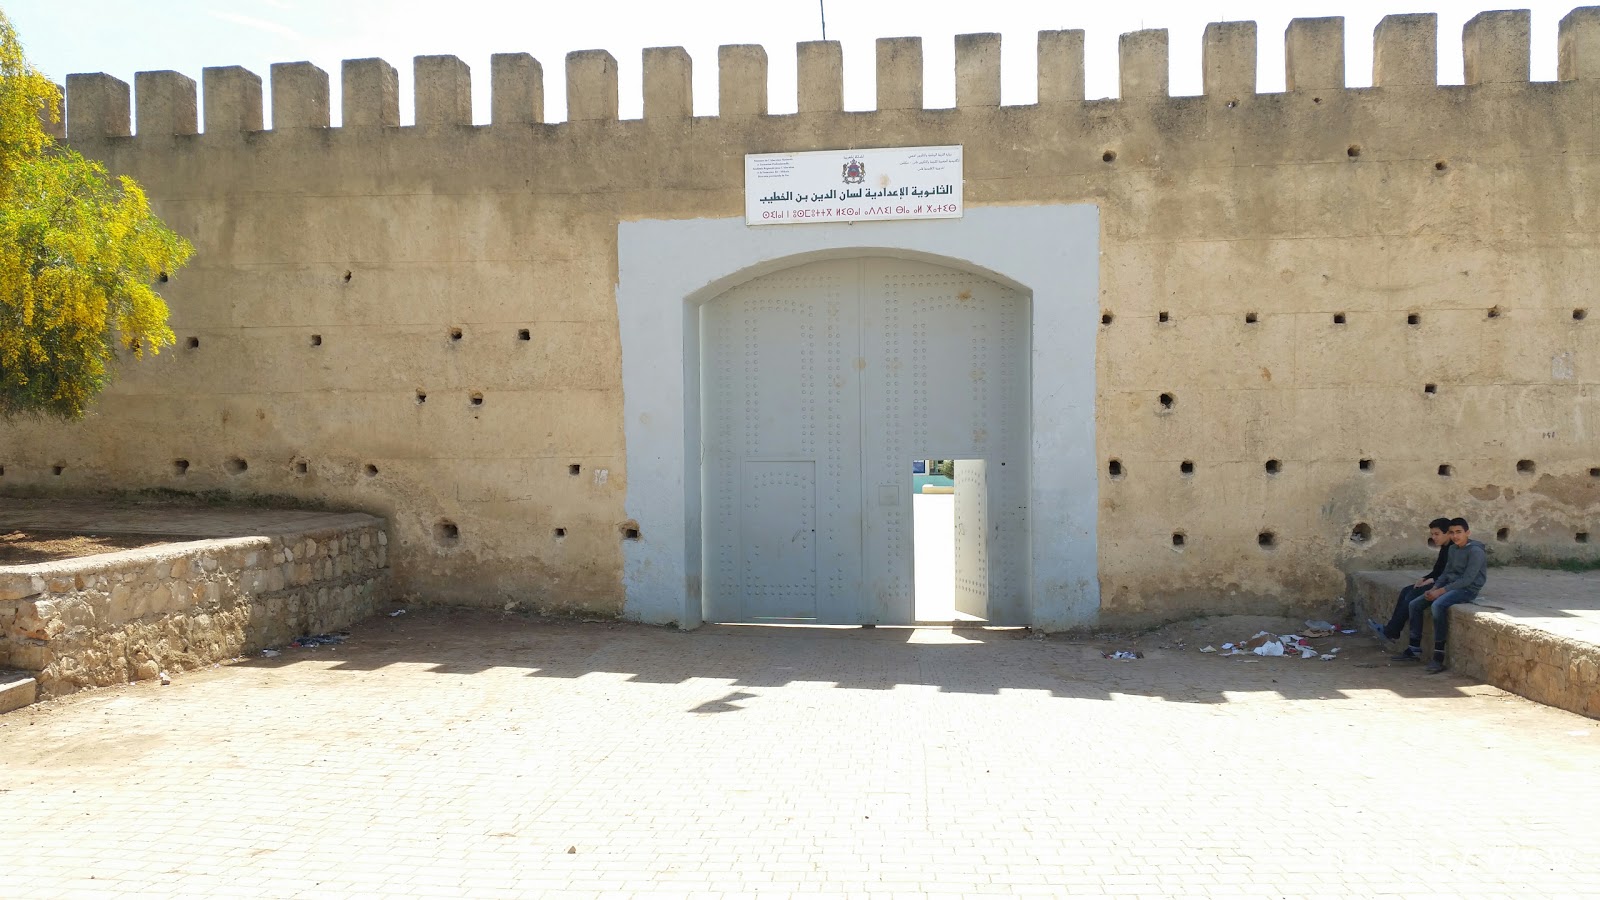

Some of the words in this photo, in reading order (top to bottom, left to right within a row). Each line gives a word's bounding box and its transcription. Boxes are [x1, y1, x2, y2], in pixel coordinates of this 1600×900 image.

[811, 190, 836, 201] الدين
[839, 188, 862, 200] لسان
[865, 187, 908, 200] الإعدادية
[912, 185, 953, 197] الثانوية
[760, 192, 792, 204] الخطيب
[796, 193, 808, 202] بن
